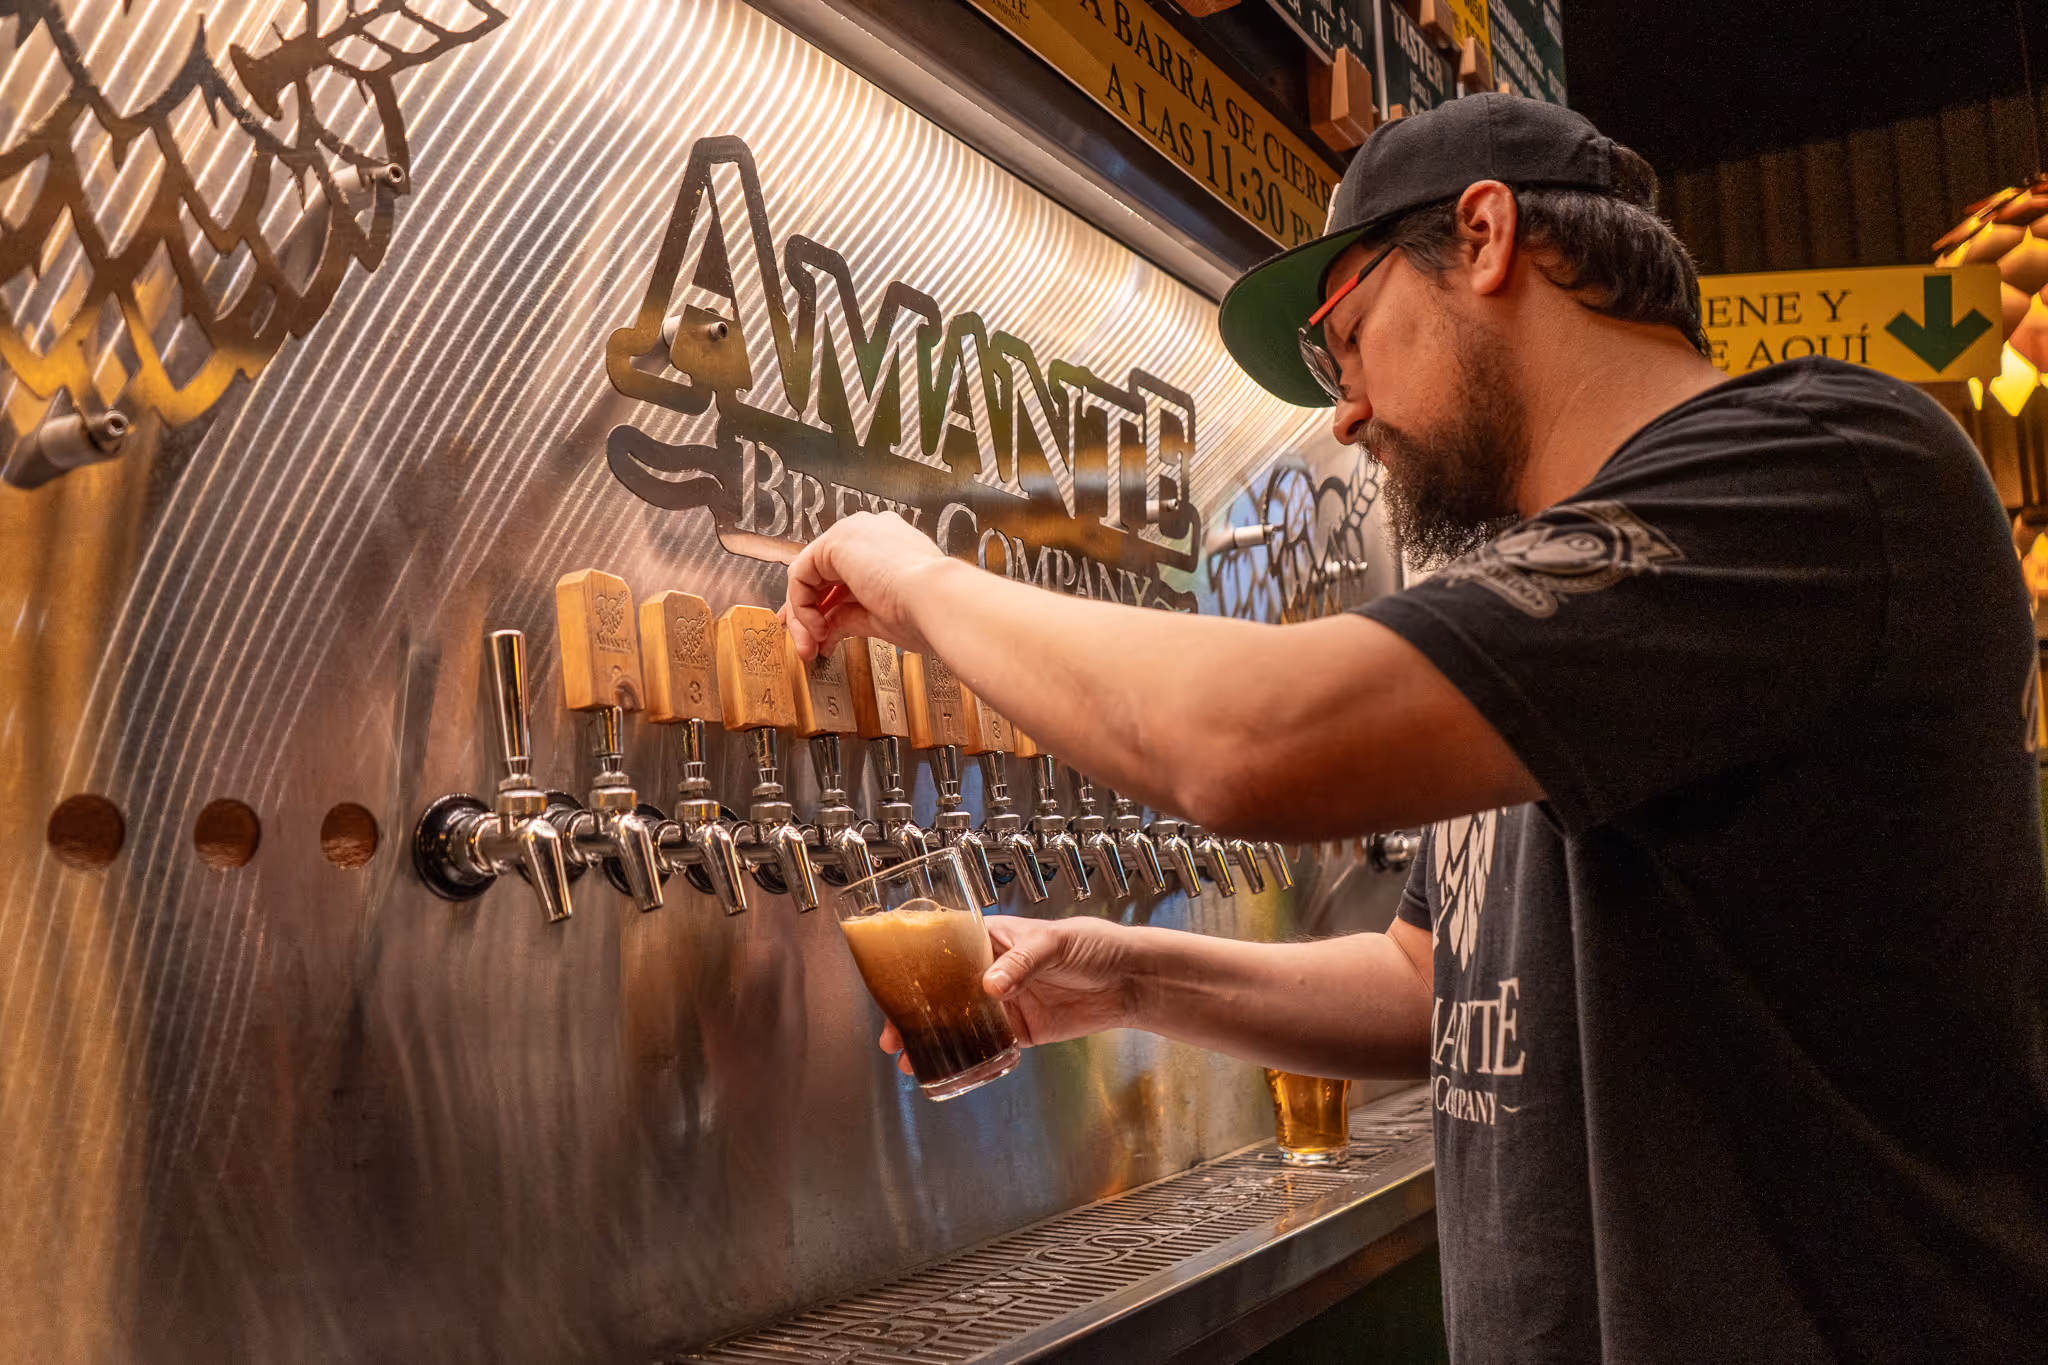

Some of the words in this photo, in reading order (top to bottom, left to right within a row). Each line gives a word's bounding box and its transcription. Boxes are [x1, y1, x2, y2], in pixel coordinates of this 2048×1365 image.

[1390, 4, 1445, 97] TASTER
[1113, 0, 1220, 126] BARRA
[1225, 97, 1257, 156] SE
[1105, 62, 1131, 116] A
[1134, 82, 1195, 167] LAS
[1202, 129, 1285, 236] 11:30
[1817, 288, 1852, 323] Y
[628, 160, 1194, 556] AMANTE
[734, 435, 923, 545] BRE
[936, 501, 1153, 608] COMPANY
[689, 680, 703, 705] 3
[761, 687, 776, 710] 4
[828, 695, 842, 718] 5
[888, 701, 898, 724] 6
[991, 720, 1002, 740] 8
